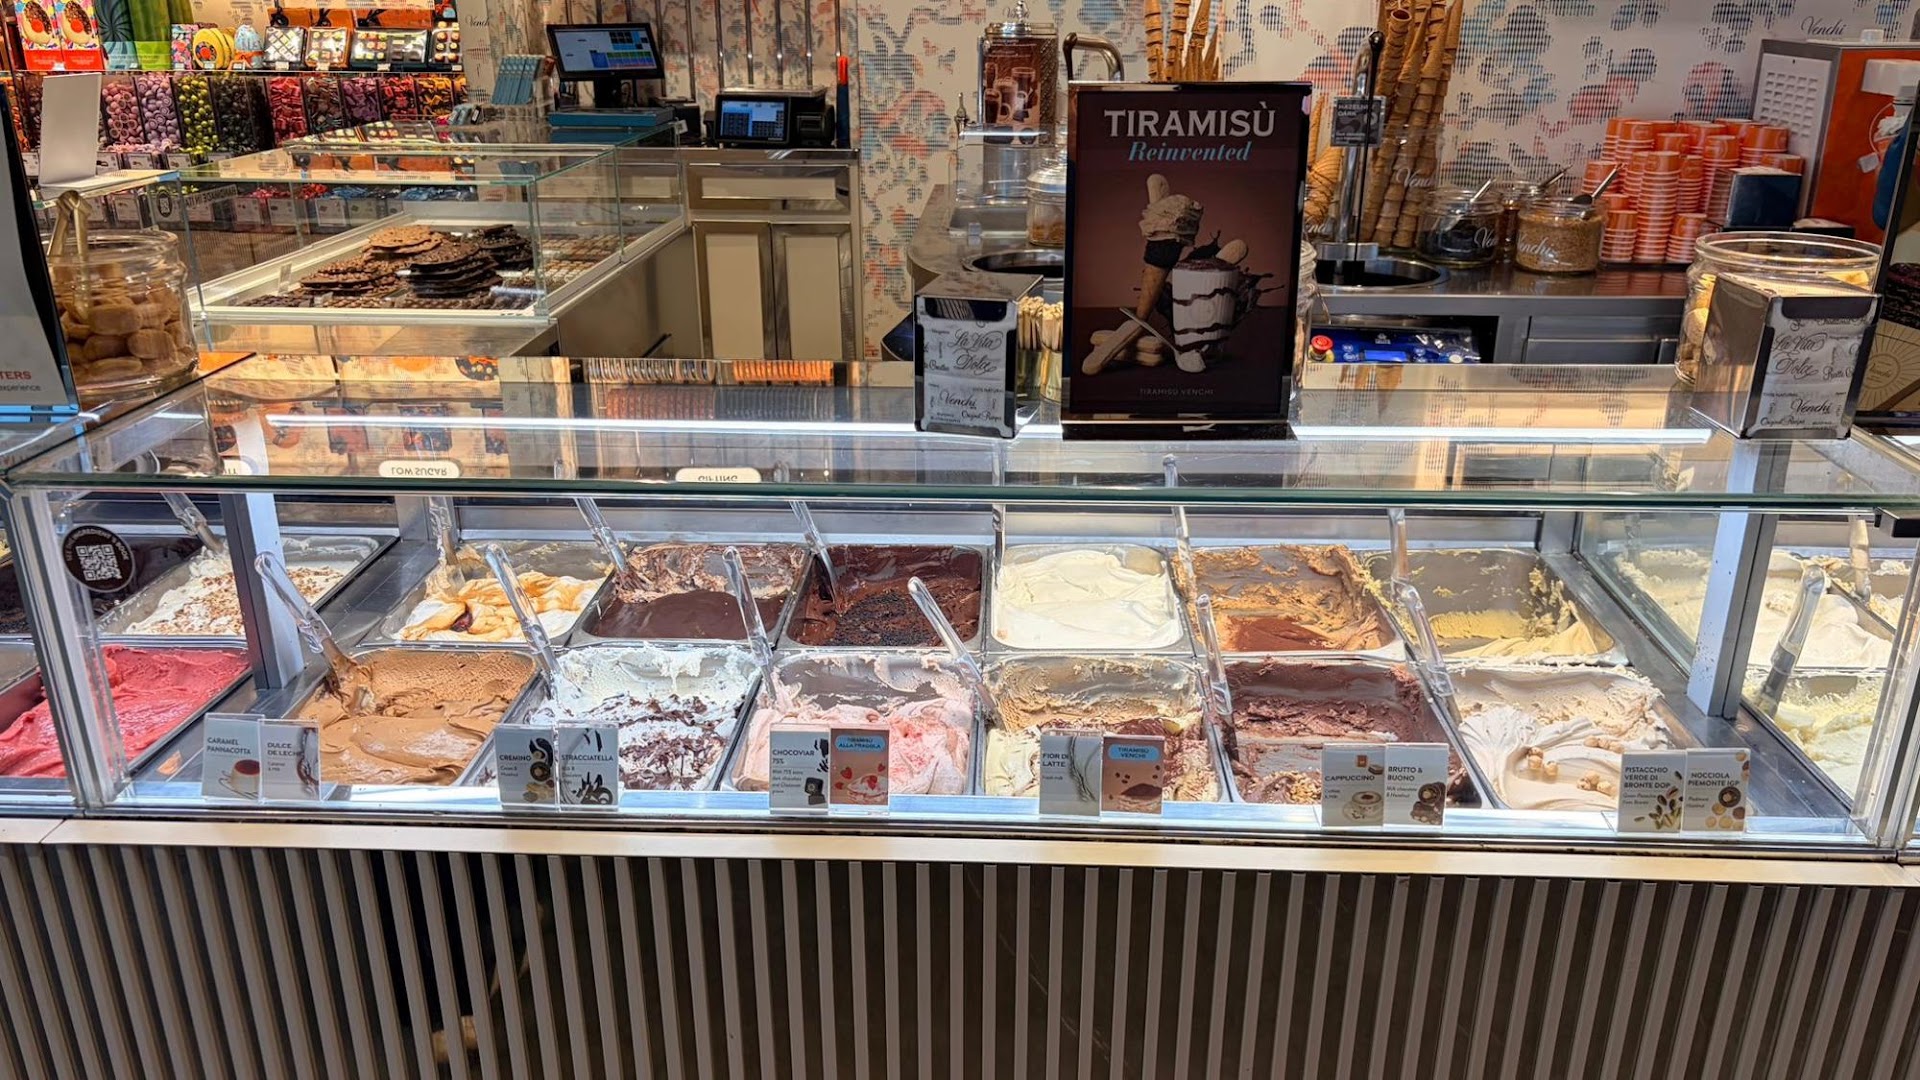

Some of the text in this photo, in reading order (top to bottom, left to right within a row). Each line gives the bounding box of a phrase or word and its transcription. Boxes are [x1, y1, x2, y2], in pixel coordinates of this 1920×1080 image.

[1801, 16, 1846, 36] Venchi
[1104, 101, 1276, 138] TIRAMISÙ
[1128, 141, 1252, 162] Reinvented
[953, 348, 997, 376] Dolce
[1772, 352, 1819, 380] Dolce
[940, 389, 977, 407] Venchi
[1181, 388, 1214, 396] VENCHI
[1791, 398, 1832, 414] Venchi
[207, 737, 239, 746] CARAMEL
[207, 746, 252, 755] PANNACOTTA
[1388, 766, 1417, 774] BRUTTO
[1388, 774, 1415, 782] BUONO
